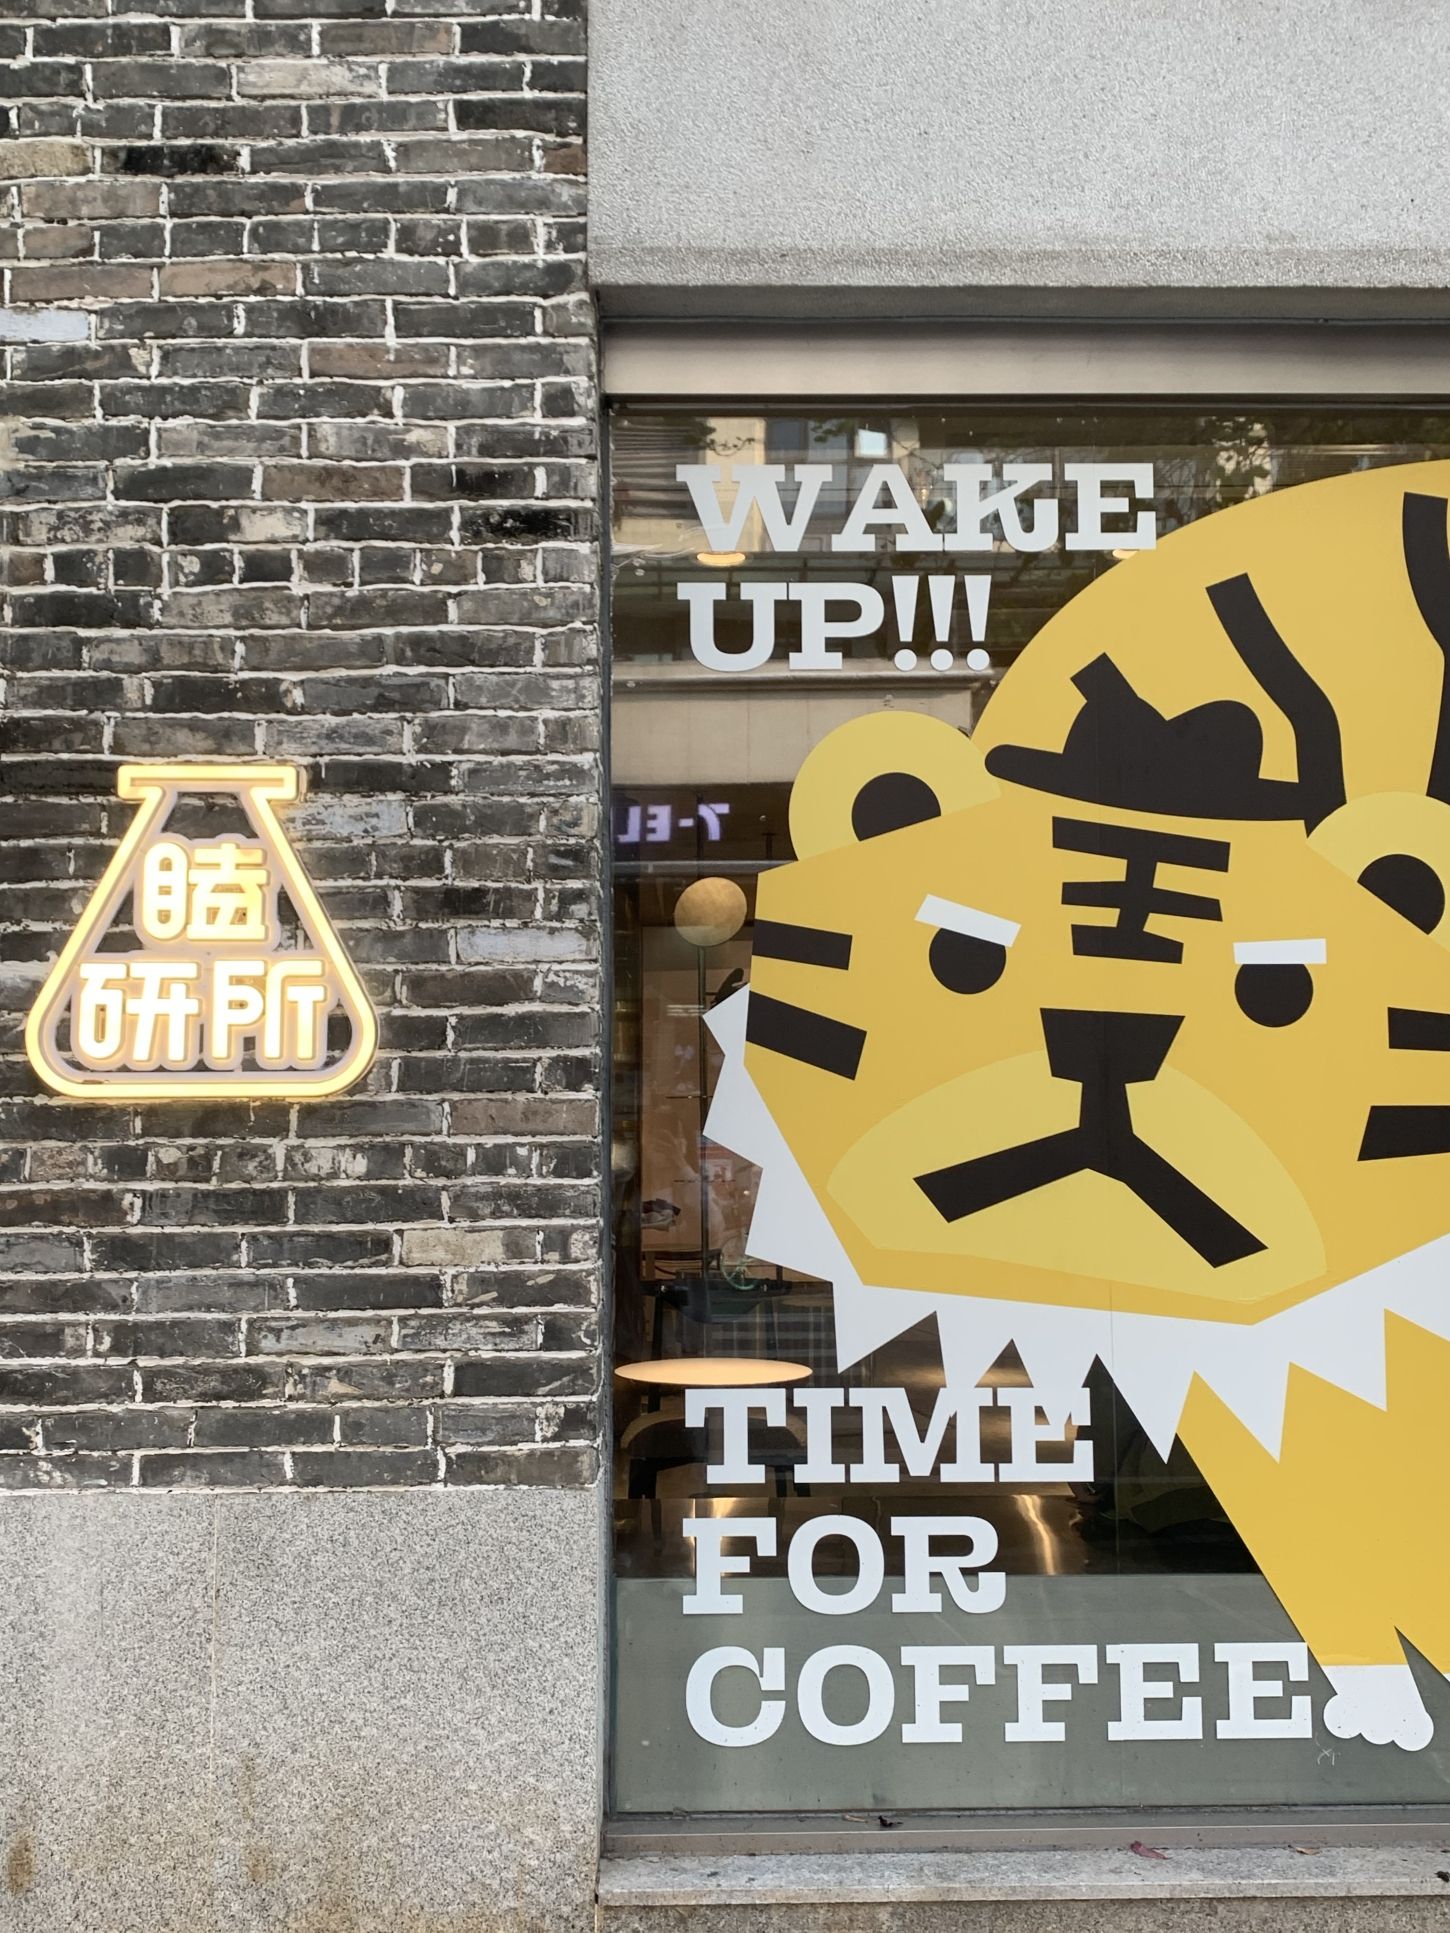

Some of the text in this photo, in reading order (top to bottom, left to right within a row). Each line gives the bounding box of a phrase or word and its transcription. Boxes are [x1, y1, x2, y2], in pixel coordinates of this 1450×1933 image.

[676, 463, 1157, 552] WAKE
[677, 574, 992, 672] UP!!!
[143, 842, 269, 941] 瞌
[79, 960, 326, 1062] 研所
[684, 1387, 1095, 1484] TIME
[682, 1514, 1007, 1615] FOR
[685, 1641, 1313, 1748] COFFEE
